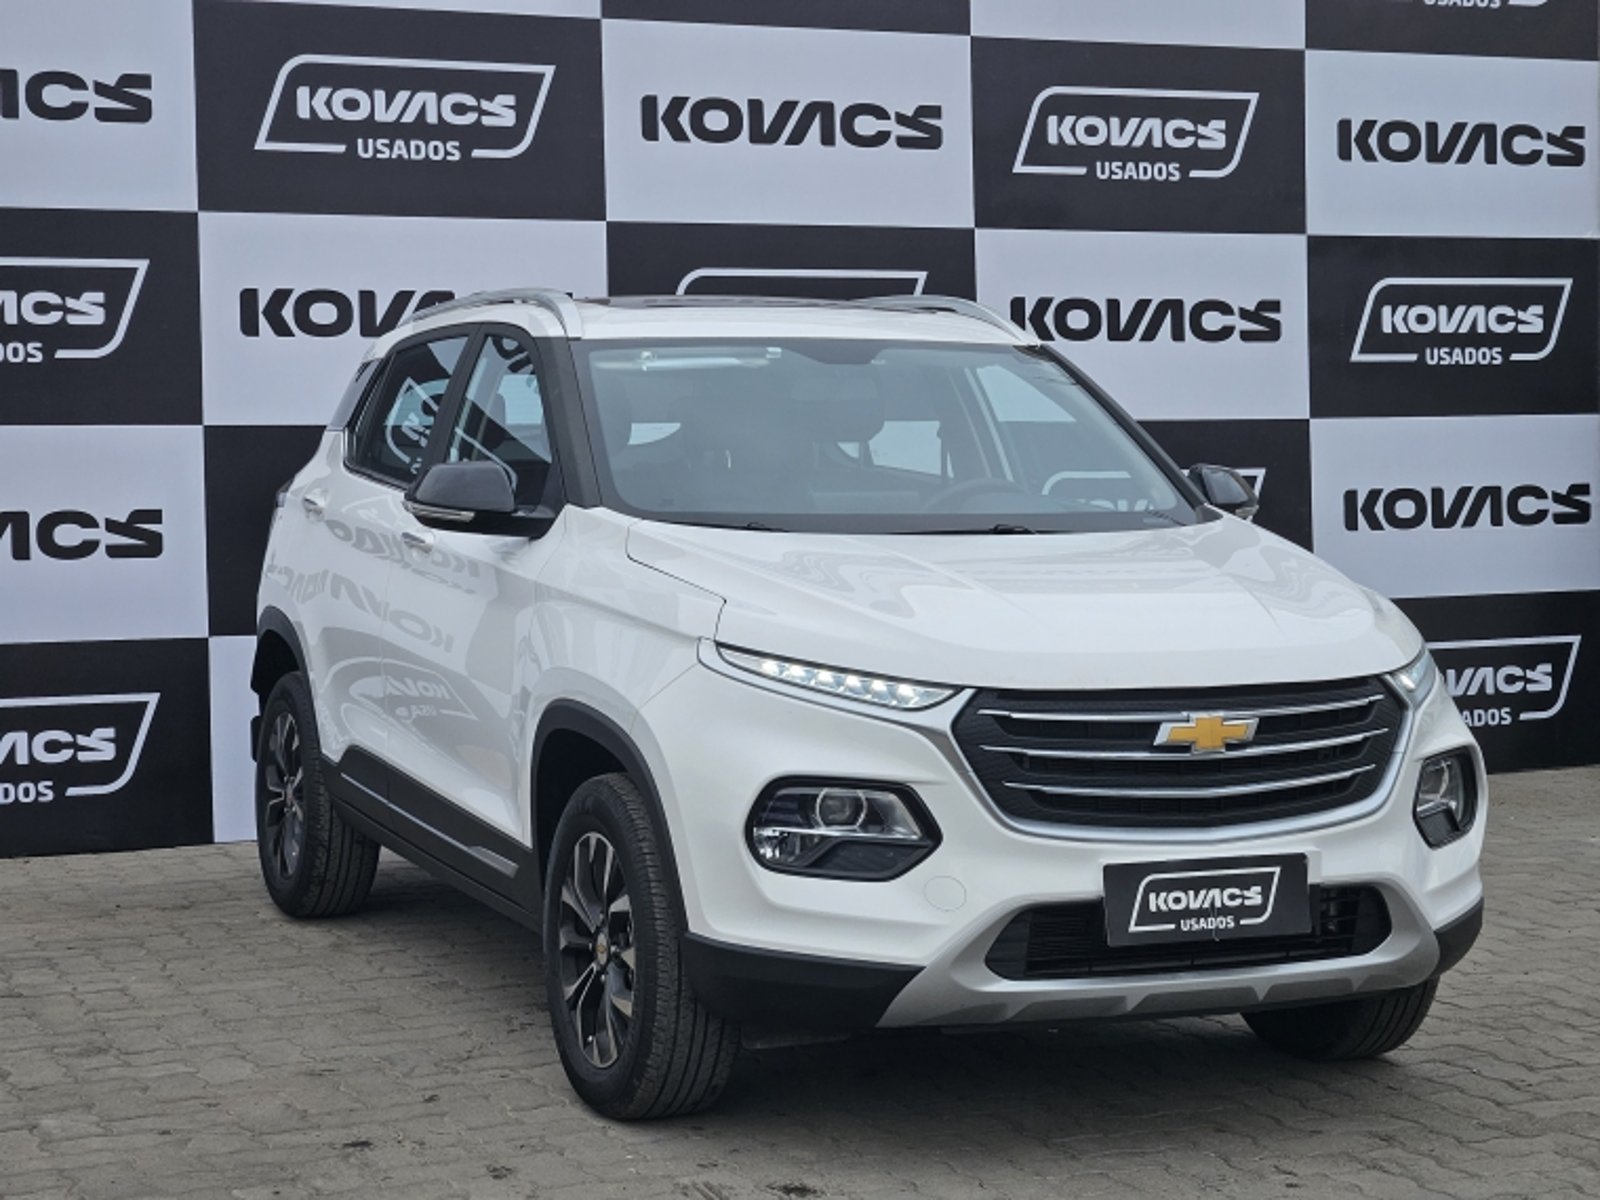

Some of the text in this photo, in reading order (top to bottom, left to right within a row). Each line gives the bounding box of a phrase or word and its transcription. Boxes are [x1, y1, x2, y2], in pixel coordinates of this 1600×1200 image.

[297, 86, 516, 127] KOVACS
[641, 94, 943, 149] KOVACS
[1047, 115, 1226, 149] KOVACS
[1337, 118, 1586, 167] KOVACS
[357, 138, 461, 161] USADOS
[1095, 161, 1181, 181] USADOS
[1010, 297, 1281, 342] KOVACS
[1381, 304, 1544, 334] KOVACS
[1425, 347, 1503, 366] USADOS
[1343, 483, 1591, 531] KOVACS
[1446, 663, 1552, 696] VACS
[1461, 707, 1512, 728] ADOS
[1149, 886, 1263, 912] KOVACS
[1180, 915, 1235, 932] USADOS
